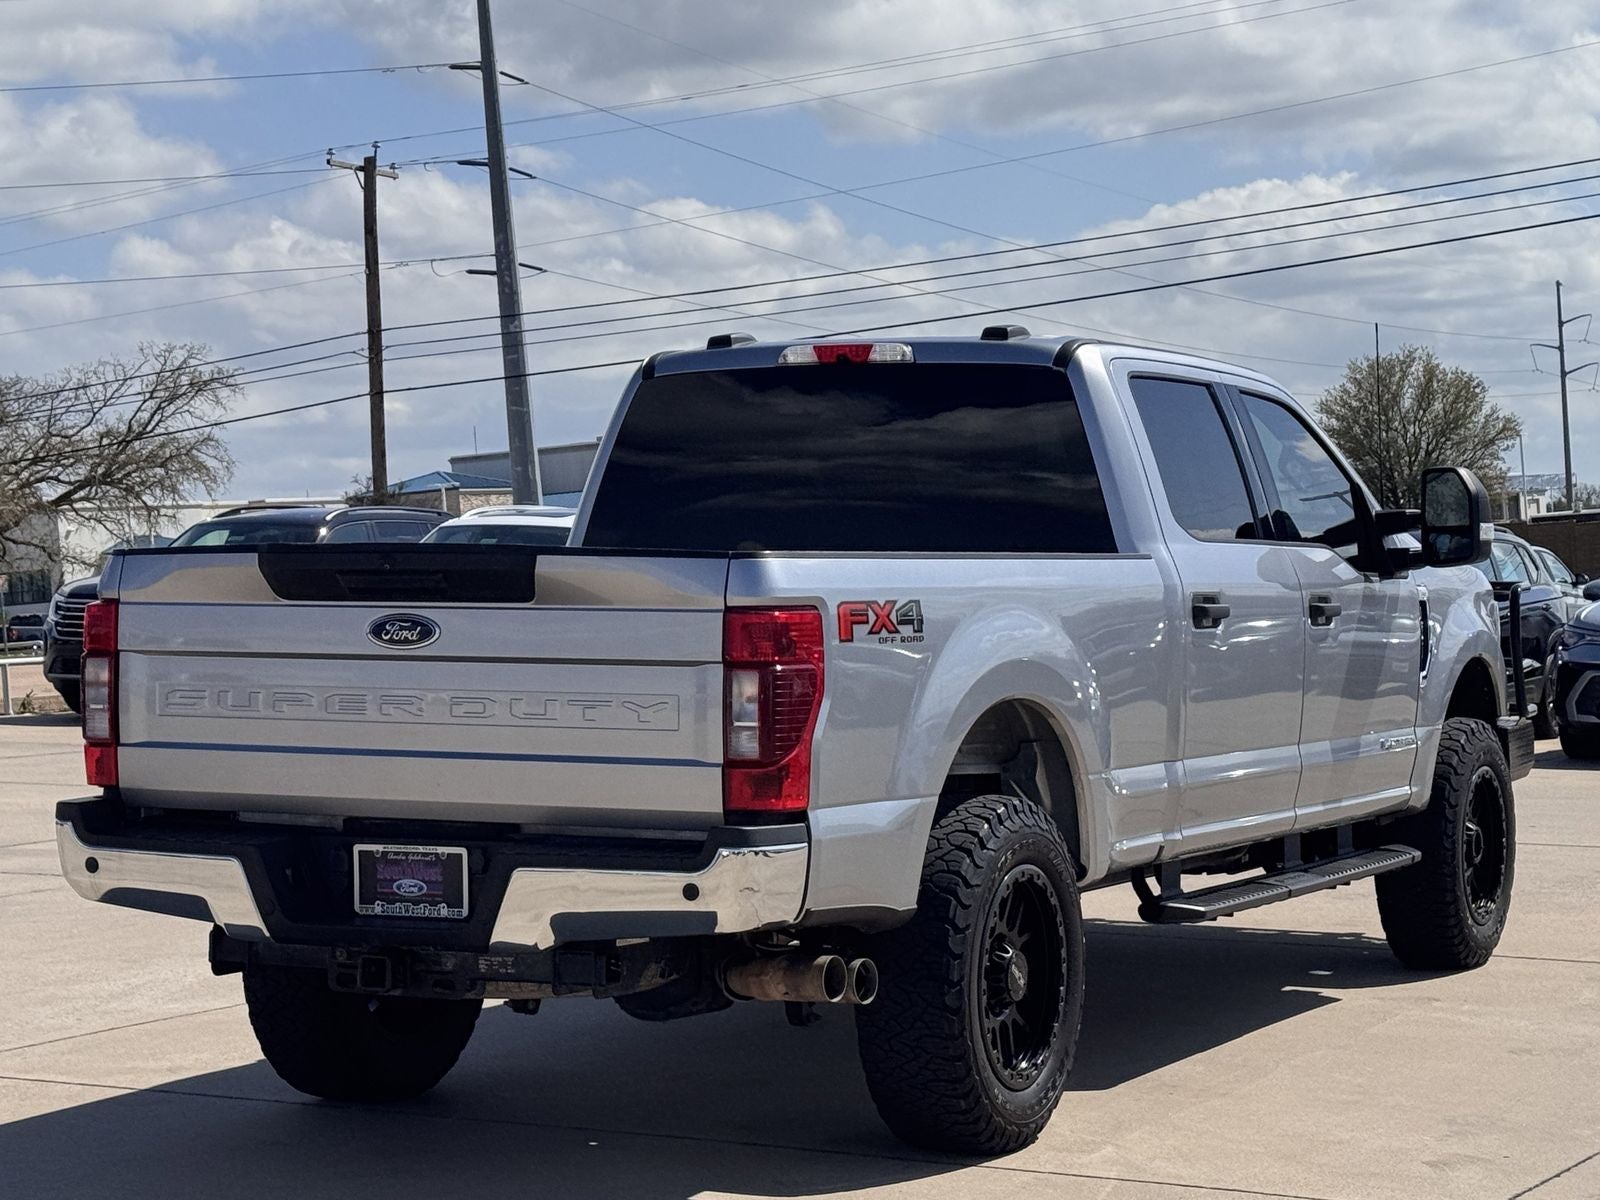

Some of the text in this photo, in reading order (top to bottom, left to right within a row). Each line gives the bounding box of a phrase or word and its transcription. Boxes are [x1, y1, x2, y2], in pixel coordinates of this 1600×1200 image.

[381, 620, 421, 640] Ford
[837, 599, 924, 643] FX4
[878, 635, 925, 644] OFF ROAD
[165, 688, 671, 724] SUPER DUTY
[400, 882, 419, 893] Ford
